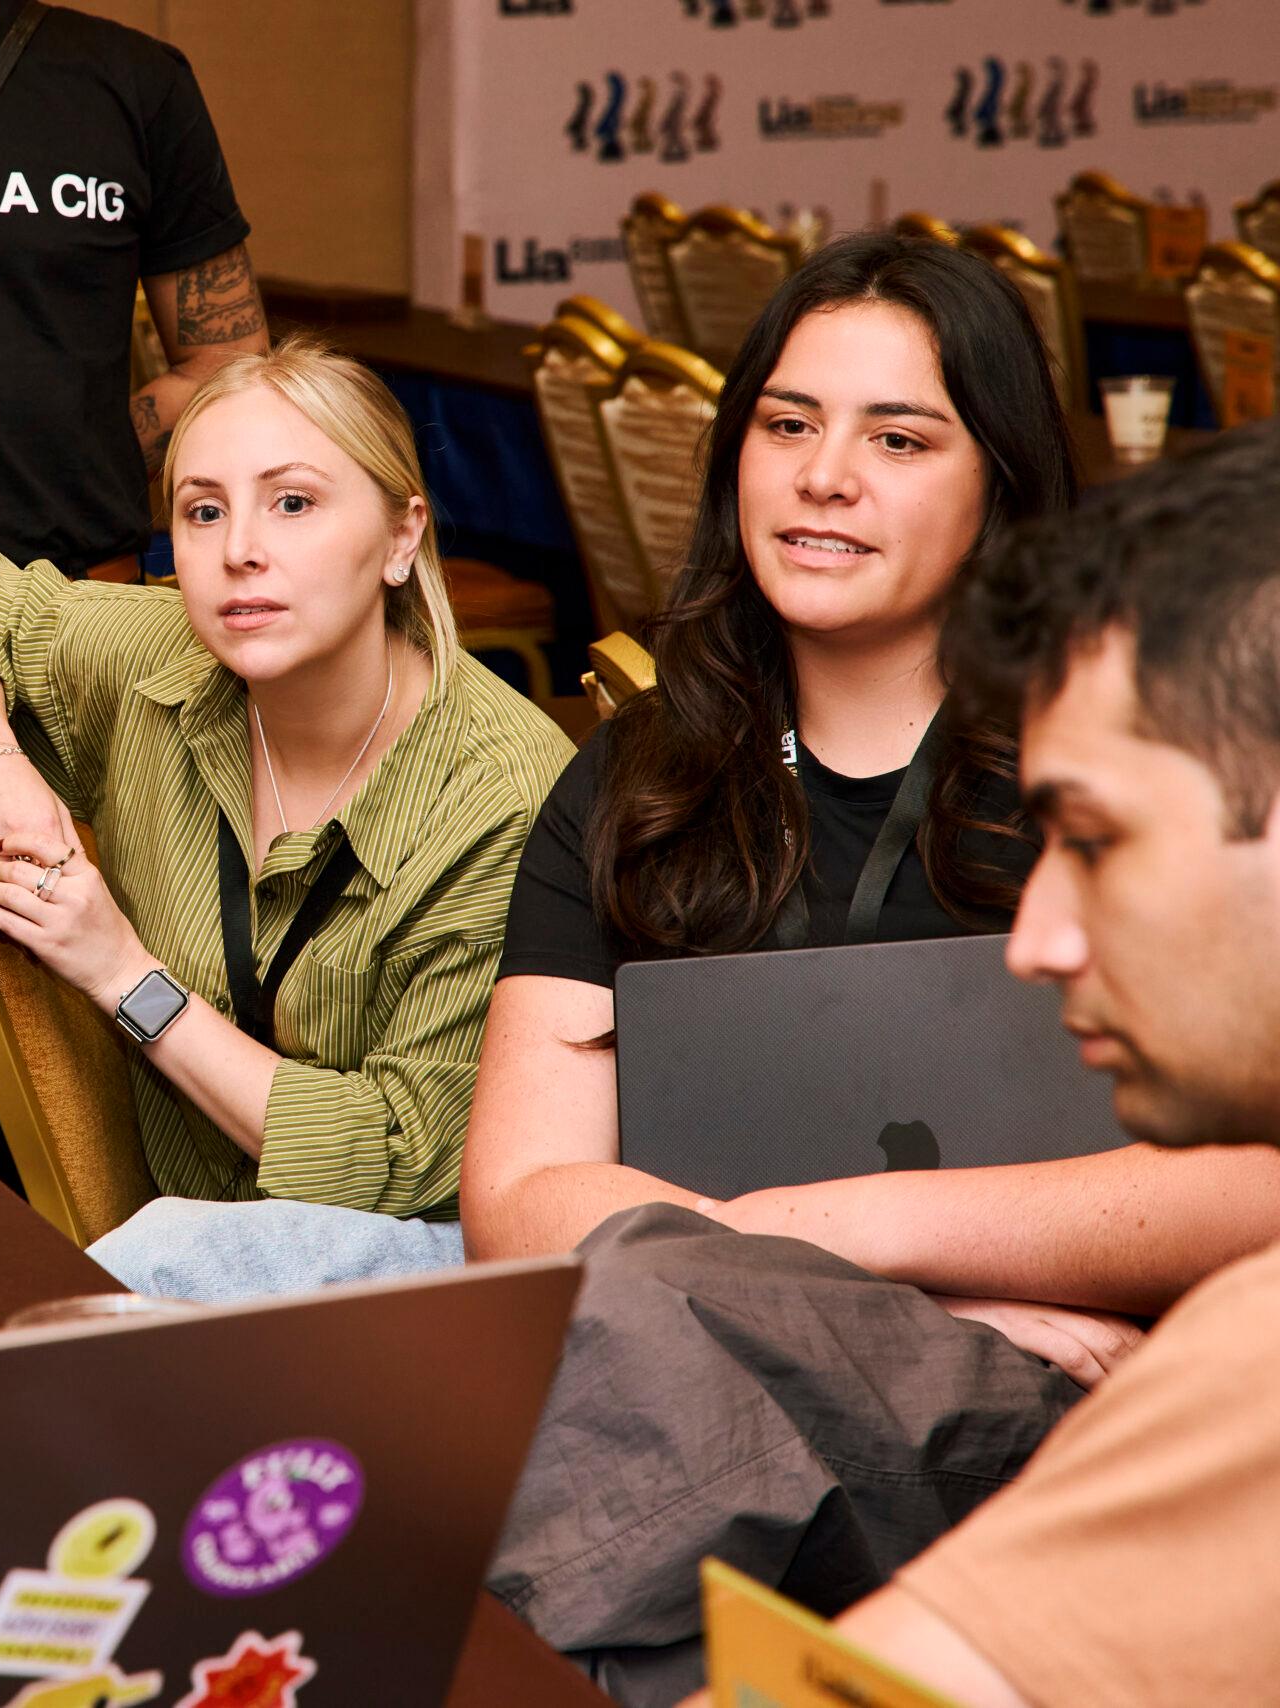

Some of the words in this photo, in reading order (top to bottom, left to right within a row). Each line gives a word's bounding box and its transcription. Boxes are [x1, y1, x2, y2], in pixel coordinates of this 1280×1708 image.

[0, 172, 39, 214] A
[51, 173, 125, 222] CIG
[781, 729, 798, 764] Lia
